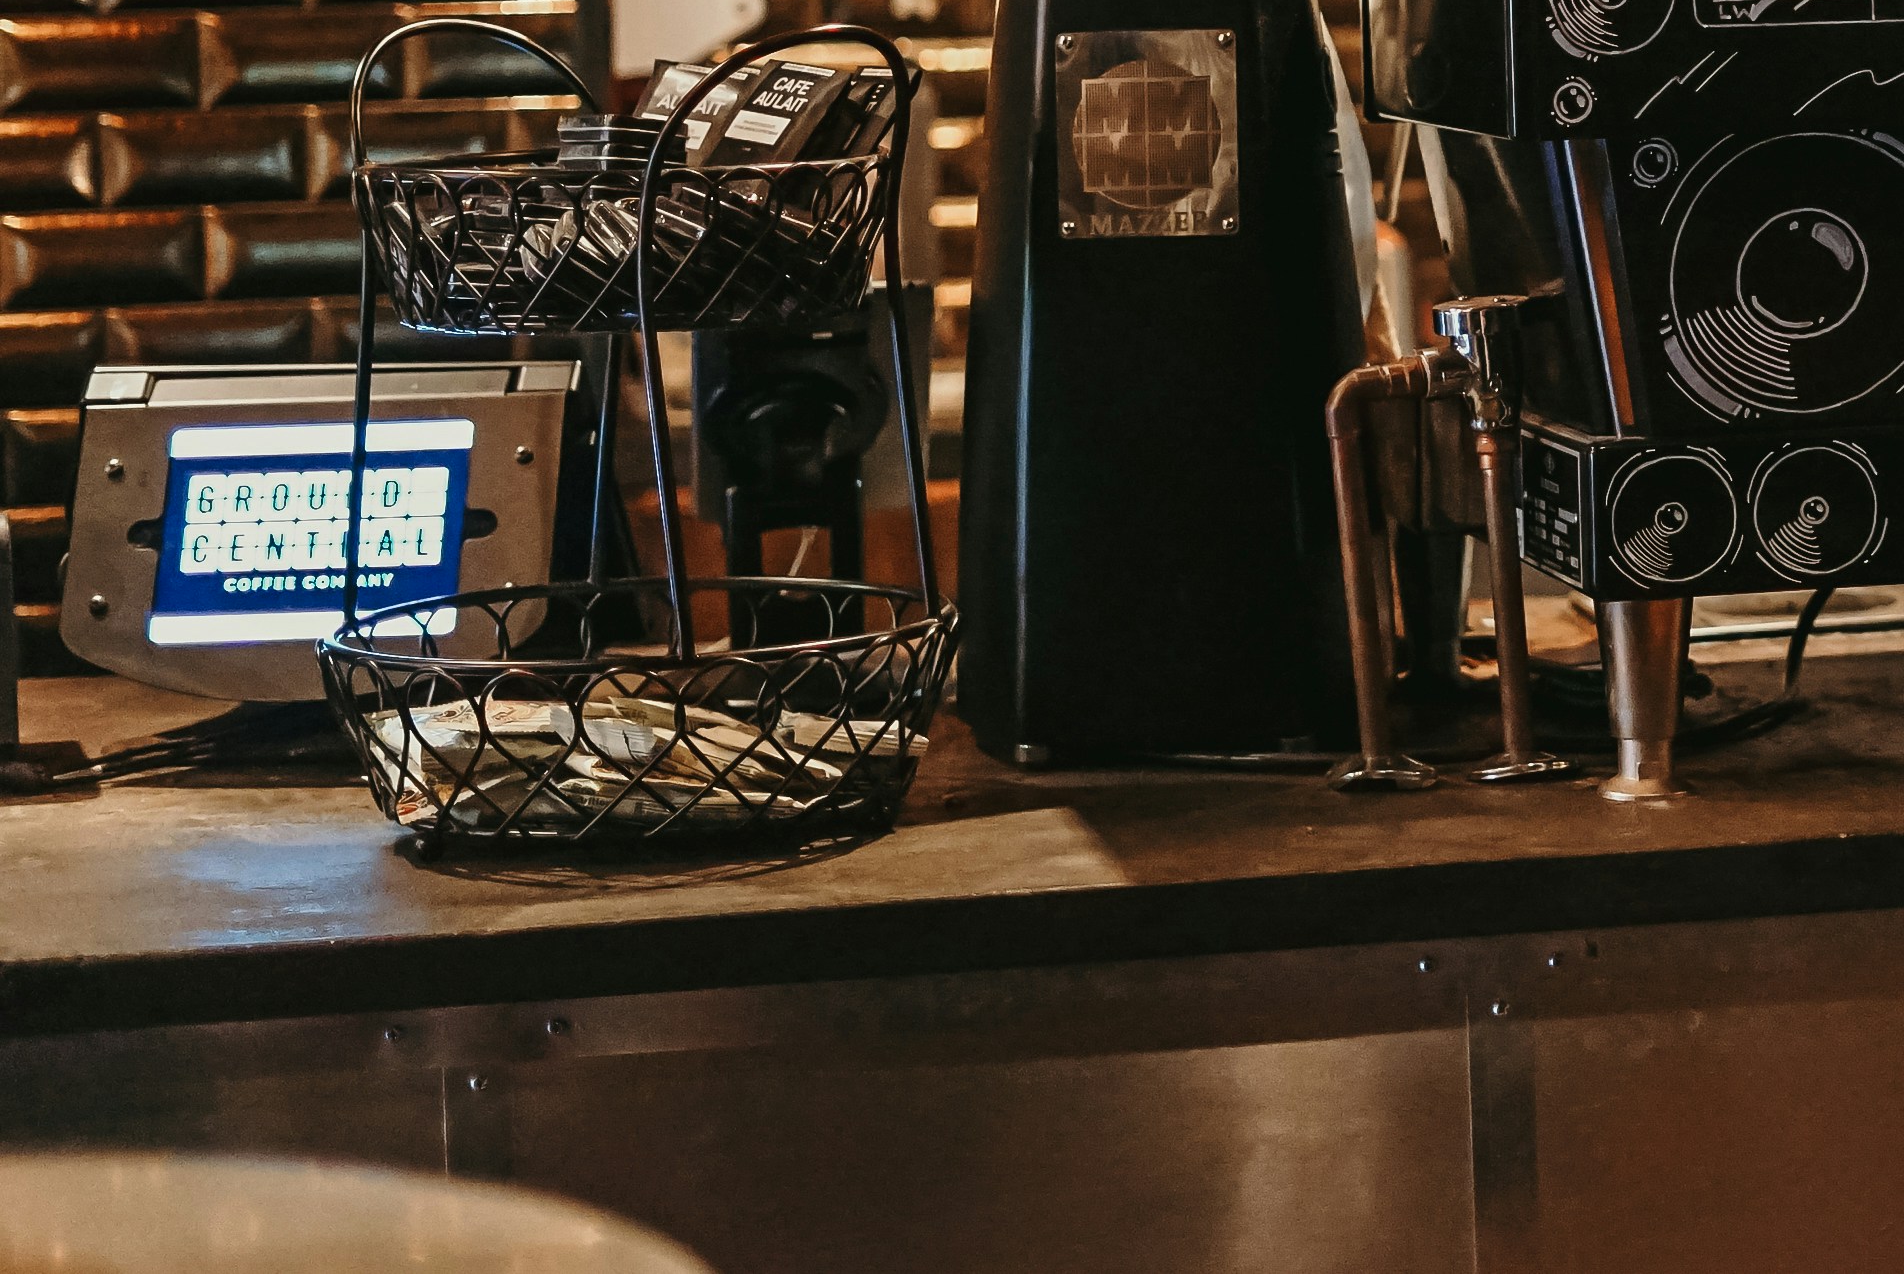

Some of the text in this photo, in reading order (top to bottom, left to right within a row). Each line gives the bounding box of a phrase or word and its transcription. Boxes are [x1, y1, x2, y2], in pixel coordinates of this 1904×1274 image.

[1719, 3, 1756, 20] LW
[773, 77, 814, 95] CAFE
[199, 480, 400, 513] GROUD
[223, 573, 394, 592] COFFEE COMANY
